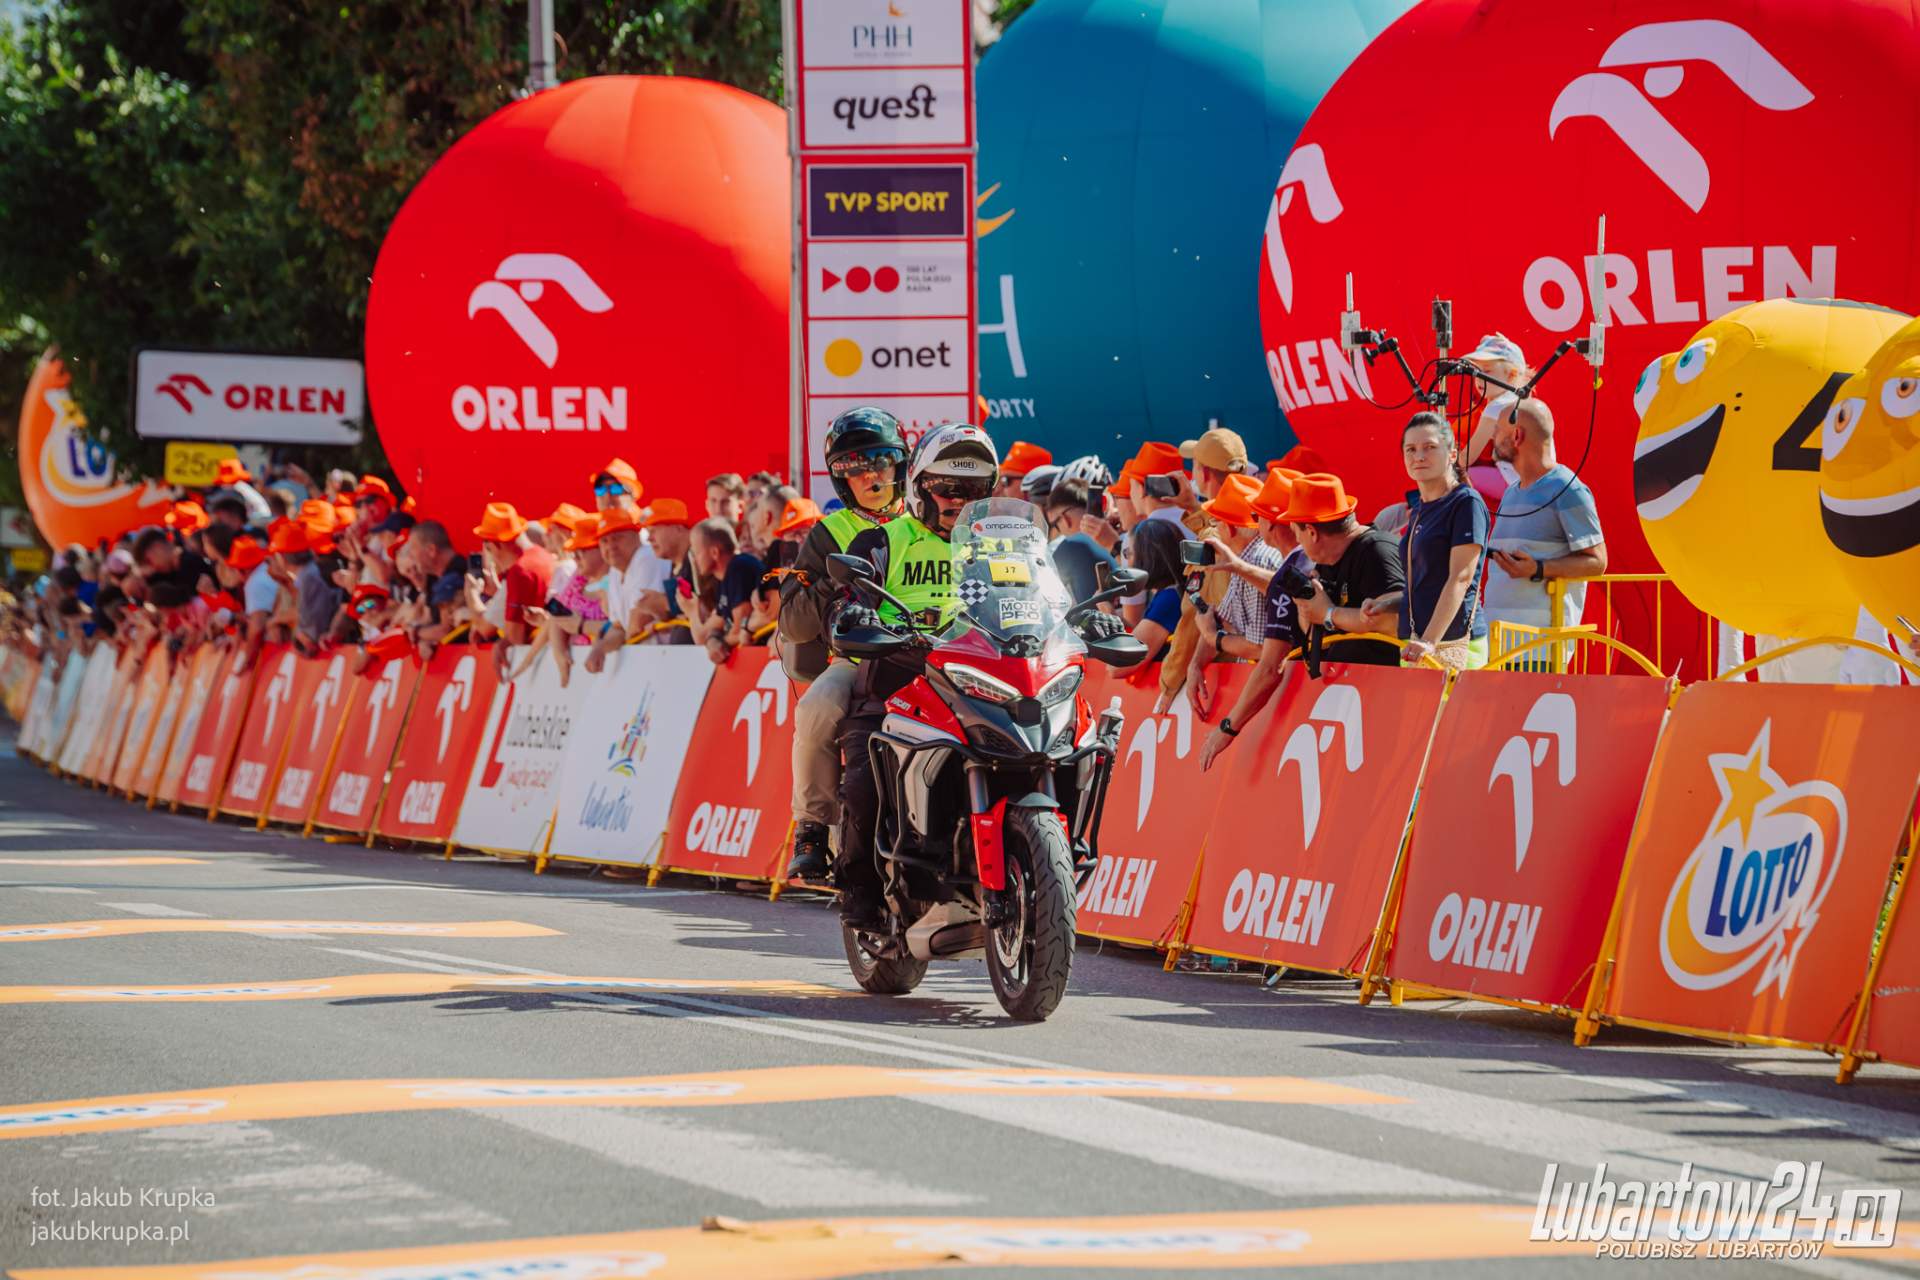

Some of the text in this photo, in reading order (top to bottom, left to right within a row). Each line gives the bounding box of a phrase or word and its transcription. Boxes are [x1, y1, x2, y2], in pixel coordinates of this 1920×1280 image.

[853, 26, 912, 48] PHH
[833, 84, 937, 130] quest
[825, 191, 949, 212] TVP SPORT
[1522, 246, 1838, 333] ORLEN
[872, 341, 951, 368] onet
[223, 384, 346, 415] ORLEN
[451, 385, 628, 432] ORLEN
[952, 461, 976, 469] SHOEI
[685, 801, 762, 857] ORLEN
[1223, 868, 1335, 946] ORLEN
[1705, 832, 1812, 937] LOTTO
[1428, 892, 1542, 975] ORLEN
